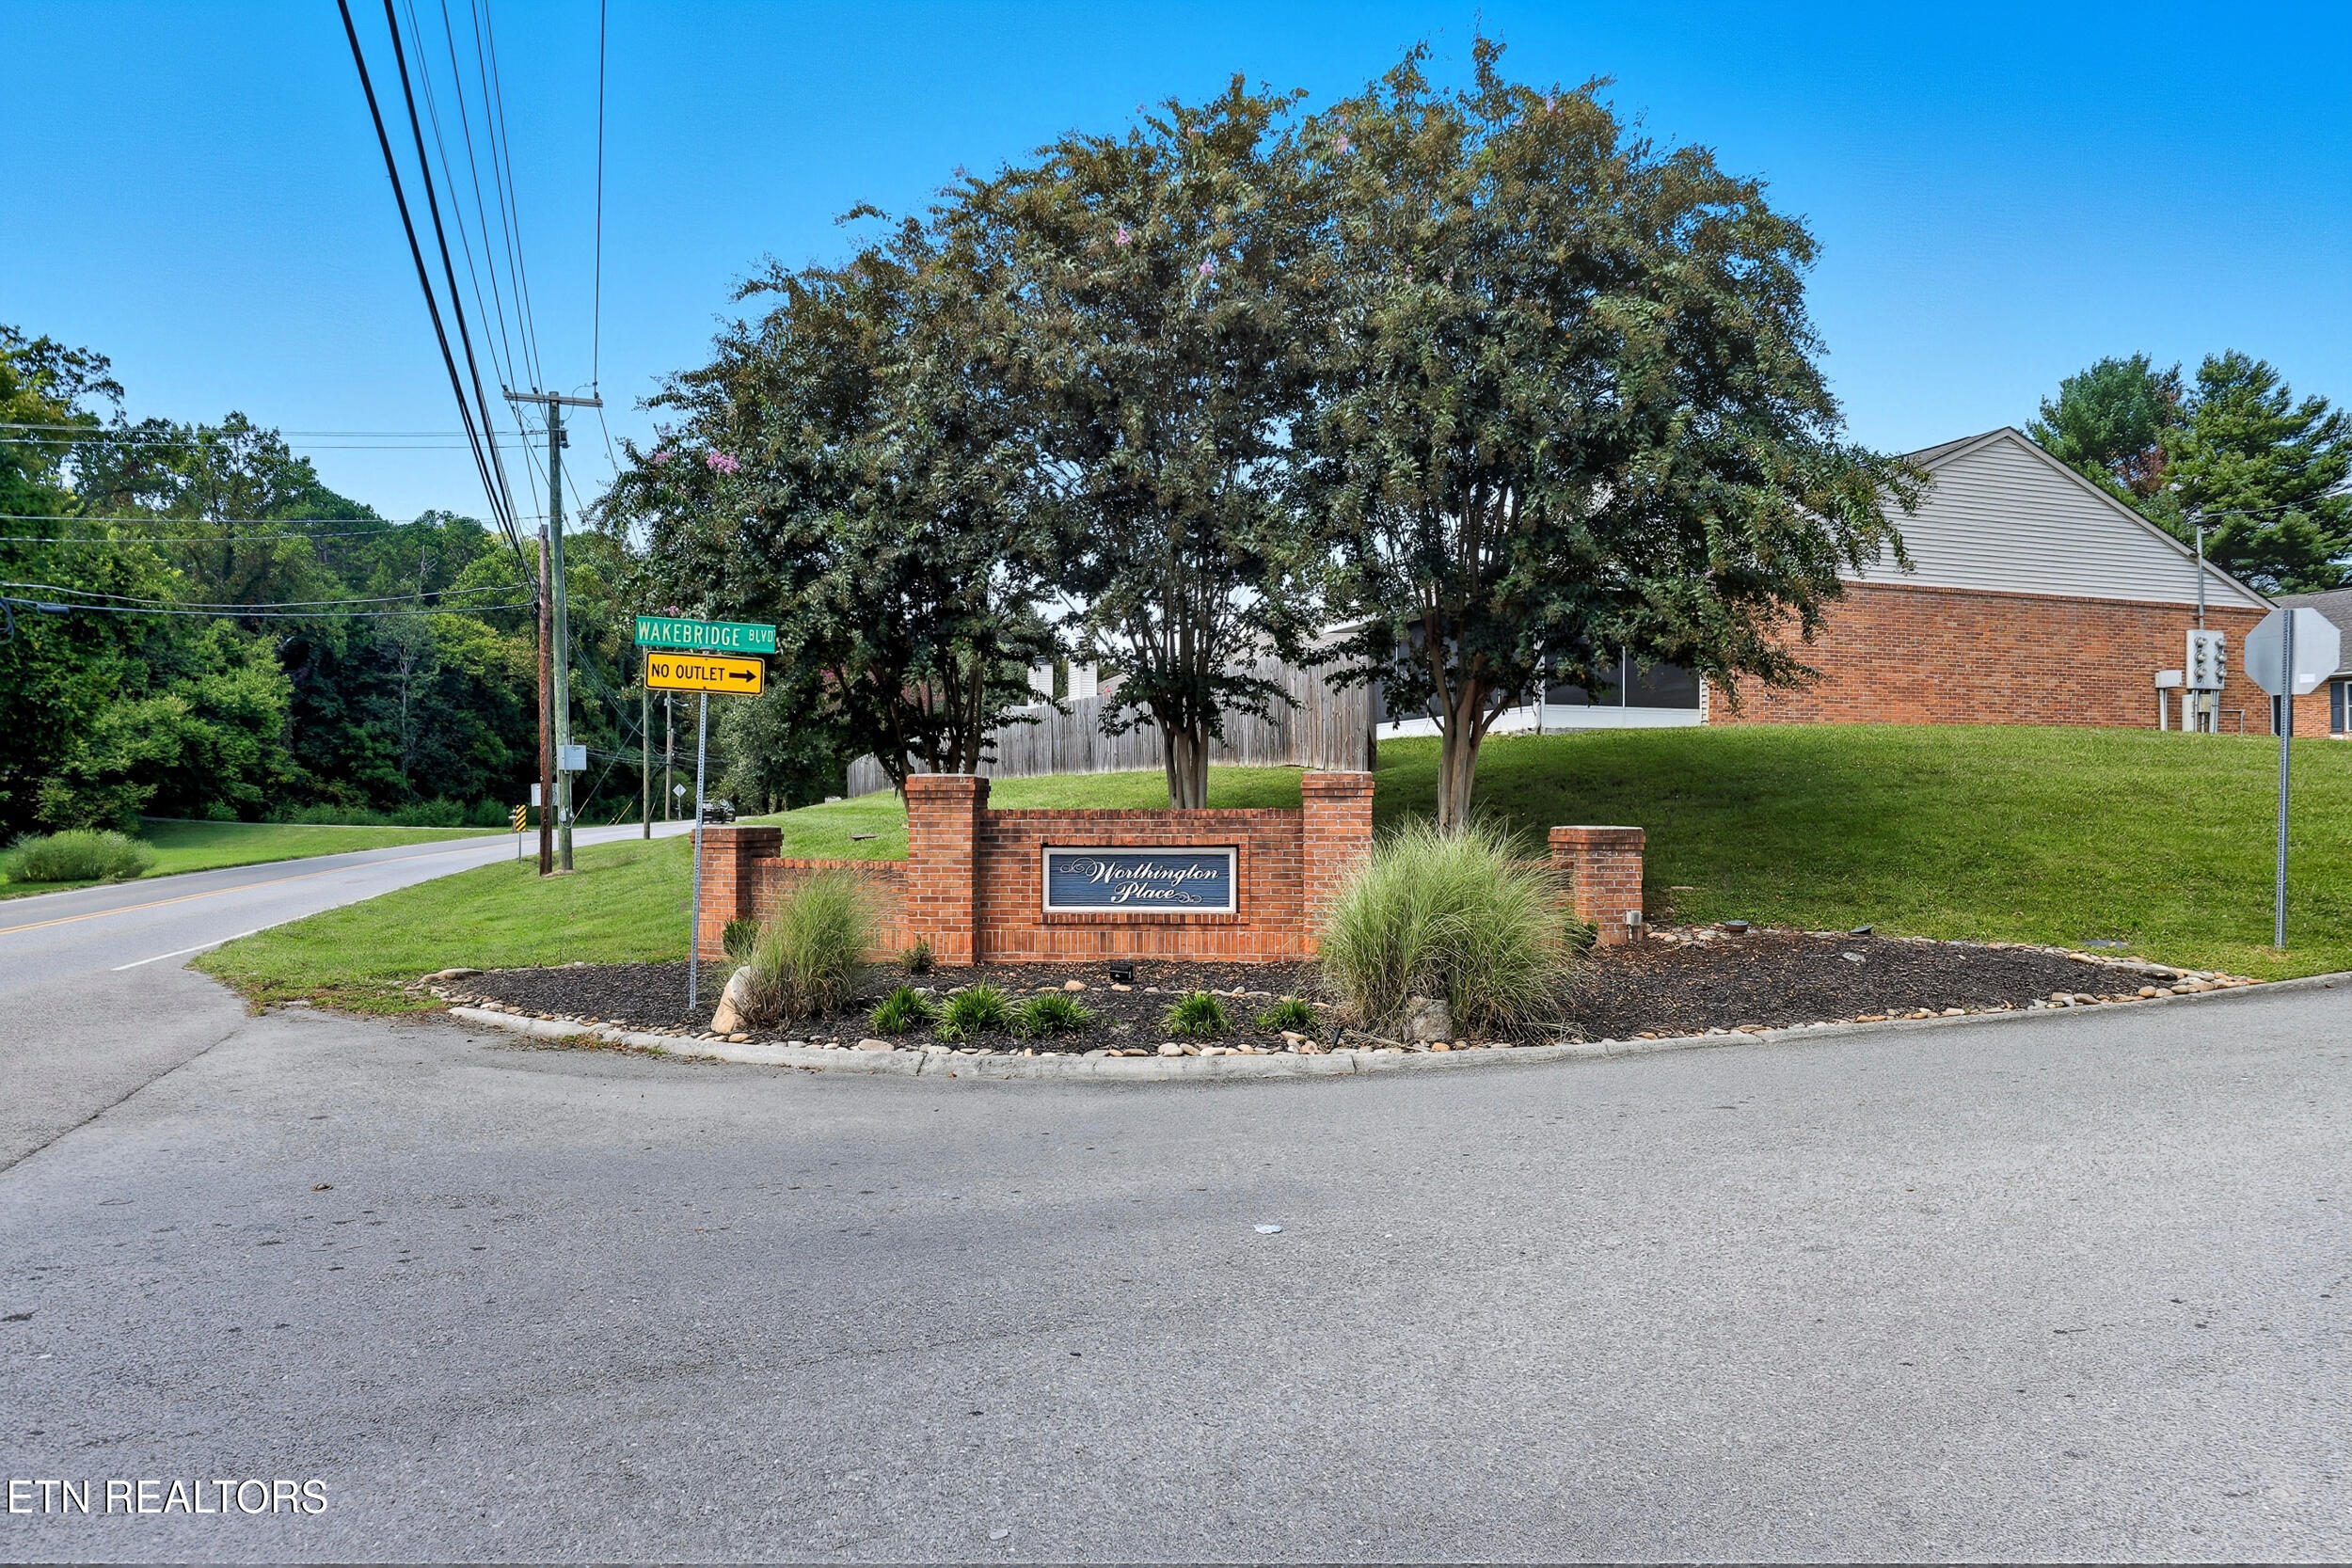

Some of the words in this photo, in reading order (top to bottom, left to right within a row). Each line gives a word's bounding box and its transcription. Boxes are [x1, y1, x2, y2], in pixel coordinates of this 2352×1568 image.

[638, 621, 740, 646] WAKEBRIDGE
[651, 663, 669, 677] NO
[675, 664, 724, 681] OUTLET
[1080, 859, 1219, 886] Worthington
[1110, 881, 1178, 904] Place
